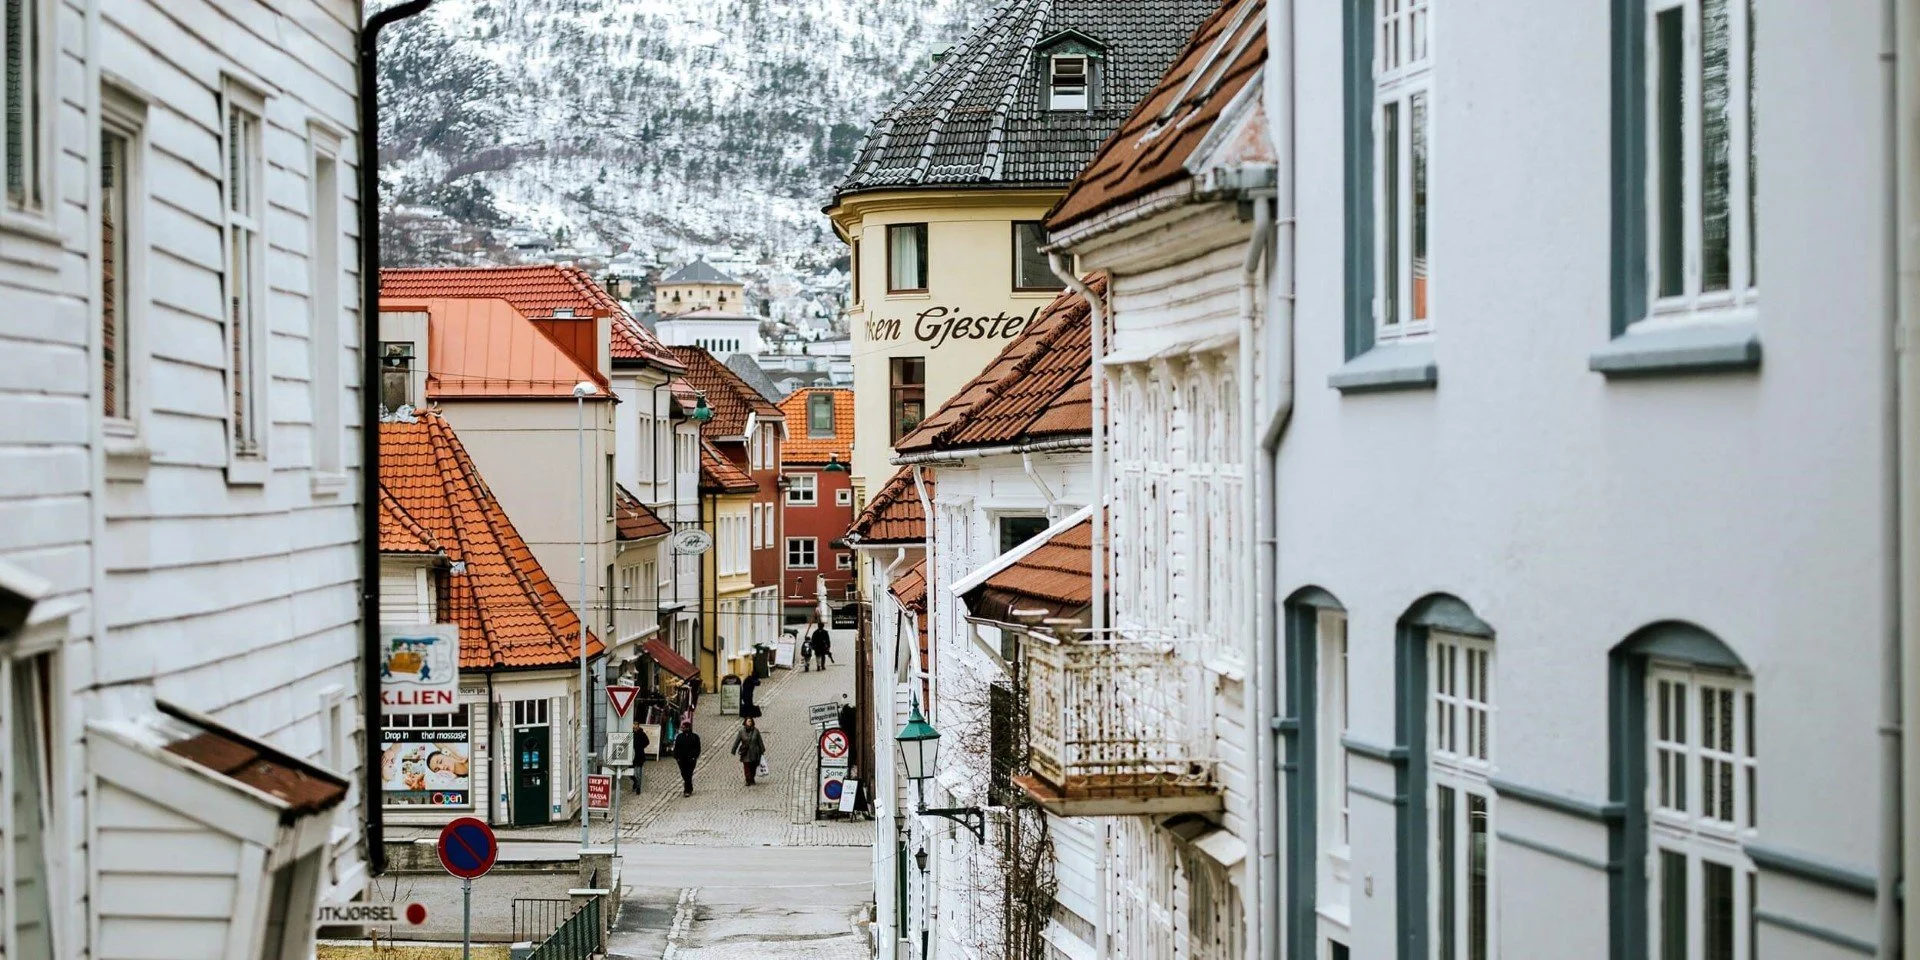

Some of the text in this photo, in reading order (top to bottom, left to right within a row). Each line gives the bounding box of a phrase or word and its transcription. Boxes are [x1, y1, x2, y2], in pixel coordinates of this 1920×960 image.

[384, 732, 401, 741] Drop
[421, 731, 435, 740] thai
[436, 731, 466, 741] massasje
[825, 769, 843, 777] Sone
[433, 792, 462, 806] Open
[588, 792, 607, 800] MASSA
